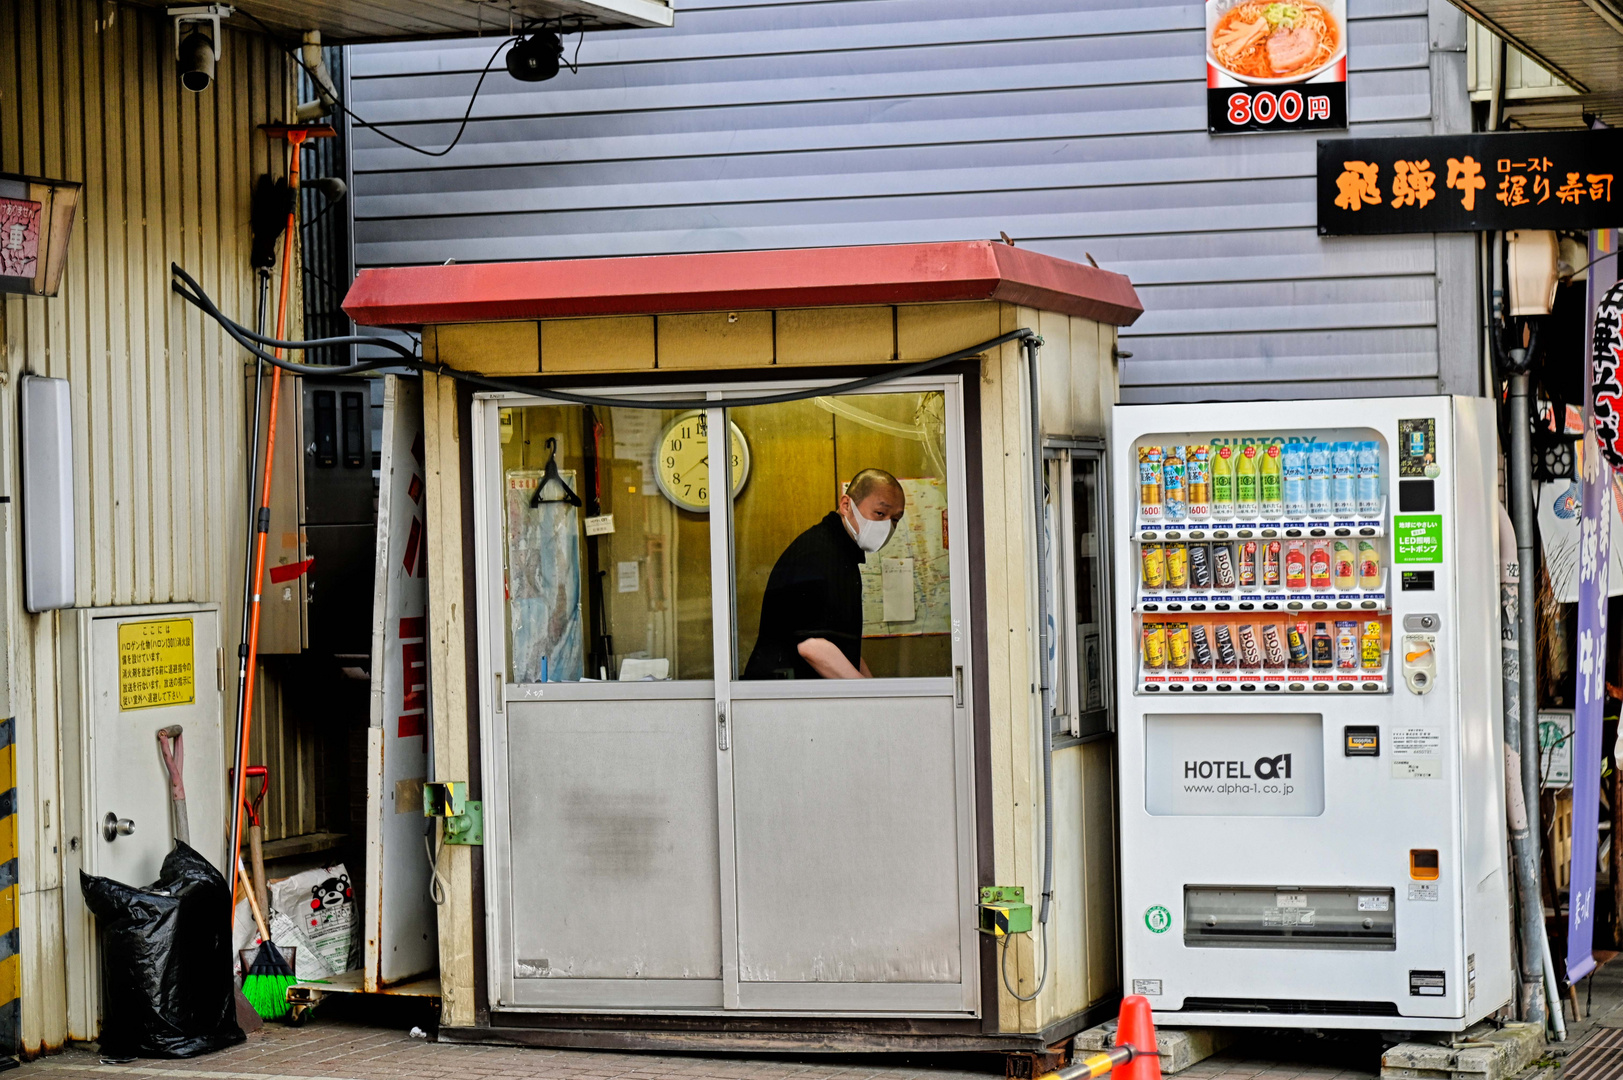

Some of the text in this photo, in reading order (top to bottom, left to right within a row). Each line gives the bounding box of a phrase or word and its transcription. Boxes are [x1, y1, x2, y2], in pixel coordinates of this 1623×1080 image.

[1227, 90, 1331, 125] 800円
[1497, 156, 1553, 173] ロースト
[1334, 155, 1486, 212] 飛騨牛
[1496, 171, 1614, 206] 握り寿司
[681, 427, 691, 439] 11
[670, 439, 682, 451] 10
[666, 456, 675, 468] 9
[732, 455, 739, 467] 3
[672, 473, 681, 484] 8
[684, 484, 691, 496] 7
[698, 487, 707, 499] 6
[1144, 507, 1159, 515] 600
[1191, 506, 1206, 514] 600
[1399, 545, 1438, 553] ヒートポンプ
[1219, 553, 1233, 584] BOSS
[143, 625, 170, 636] ここには
[1193, 626, 1212, 665] BLACK
[1217, 626, 1236, 665] BLACK
[1243, 631, 1259, 664] BOSS
[1266, 631, 1282, 664] BOSS
[1184, 760, 1251, 779] HOTEL
[1184, 783, 1294, 795] www.alpha-1.co.jp
